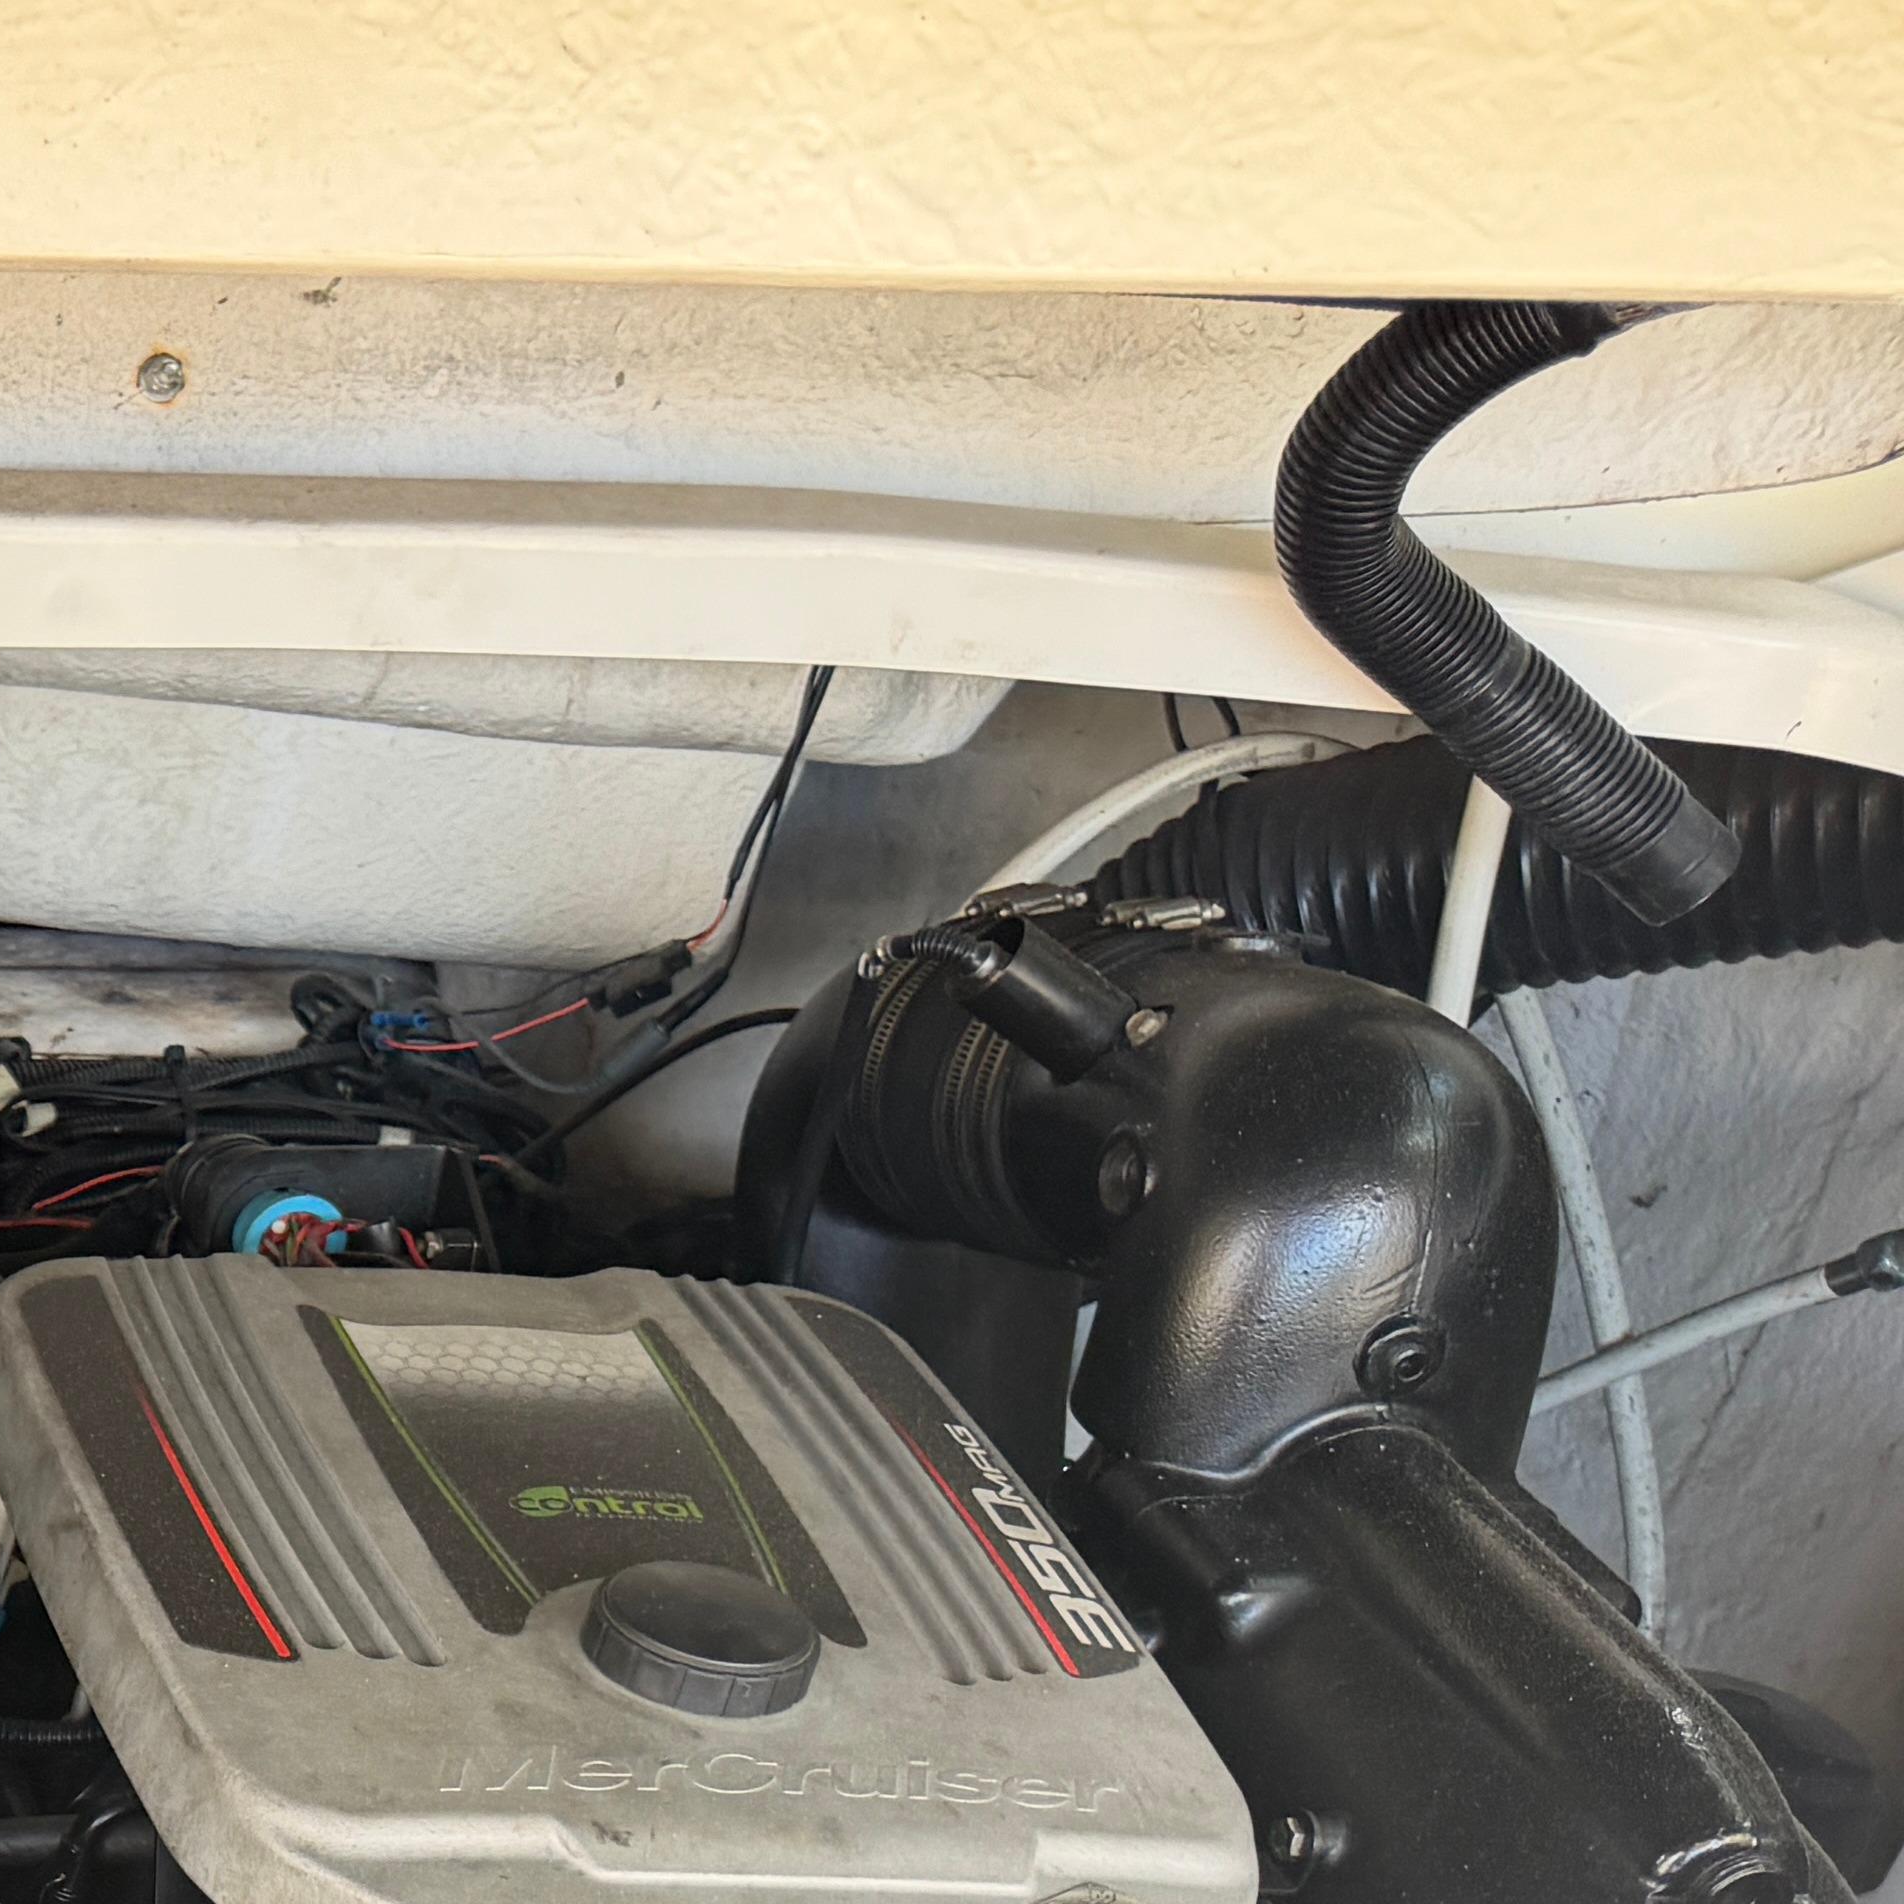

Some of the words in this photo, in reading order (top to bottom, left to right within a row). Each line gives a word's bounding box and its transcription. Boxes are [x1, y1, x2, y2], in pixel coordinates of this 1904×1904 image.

[943, 1423, 1025, 1503] MAG
[508, 1495, 704, 1520] control
[971, 1487, 1137, 1653] 350
[437, 1744, 1127, 1813] MerCruiser
